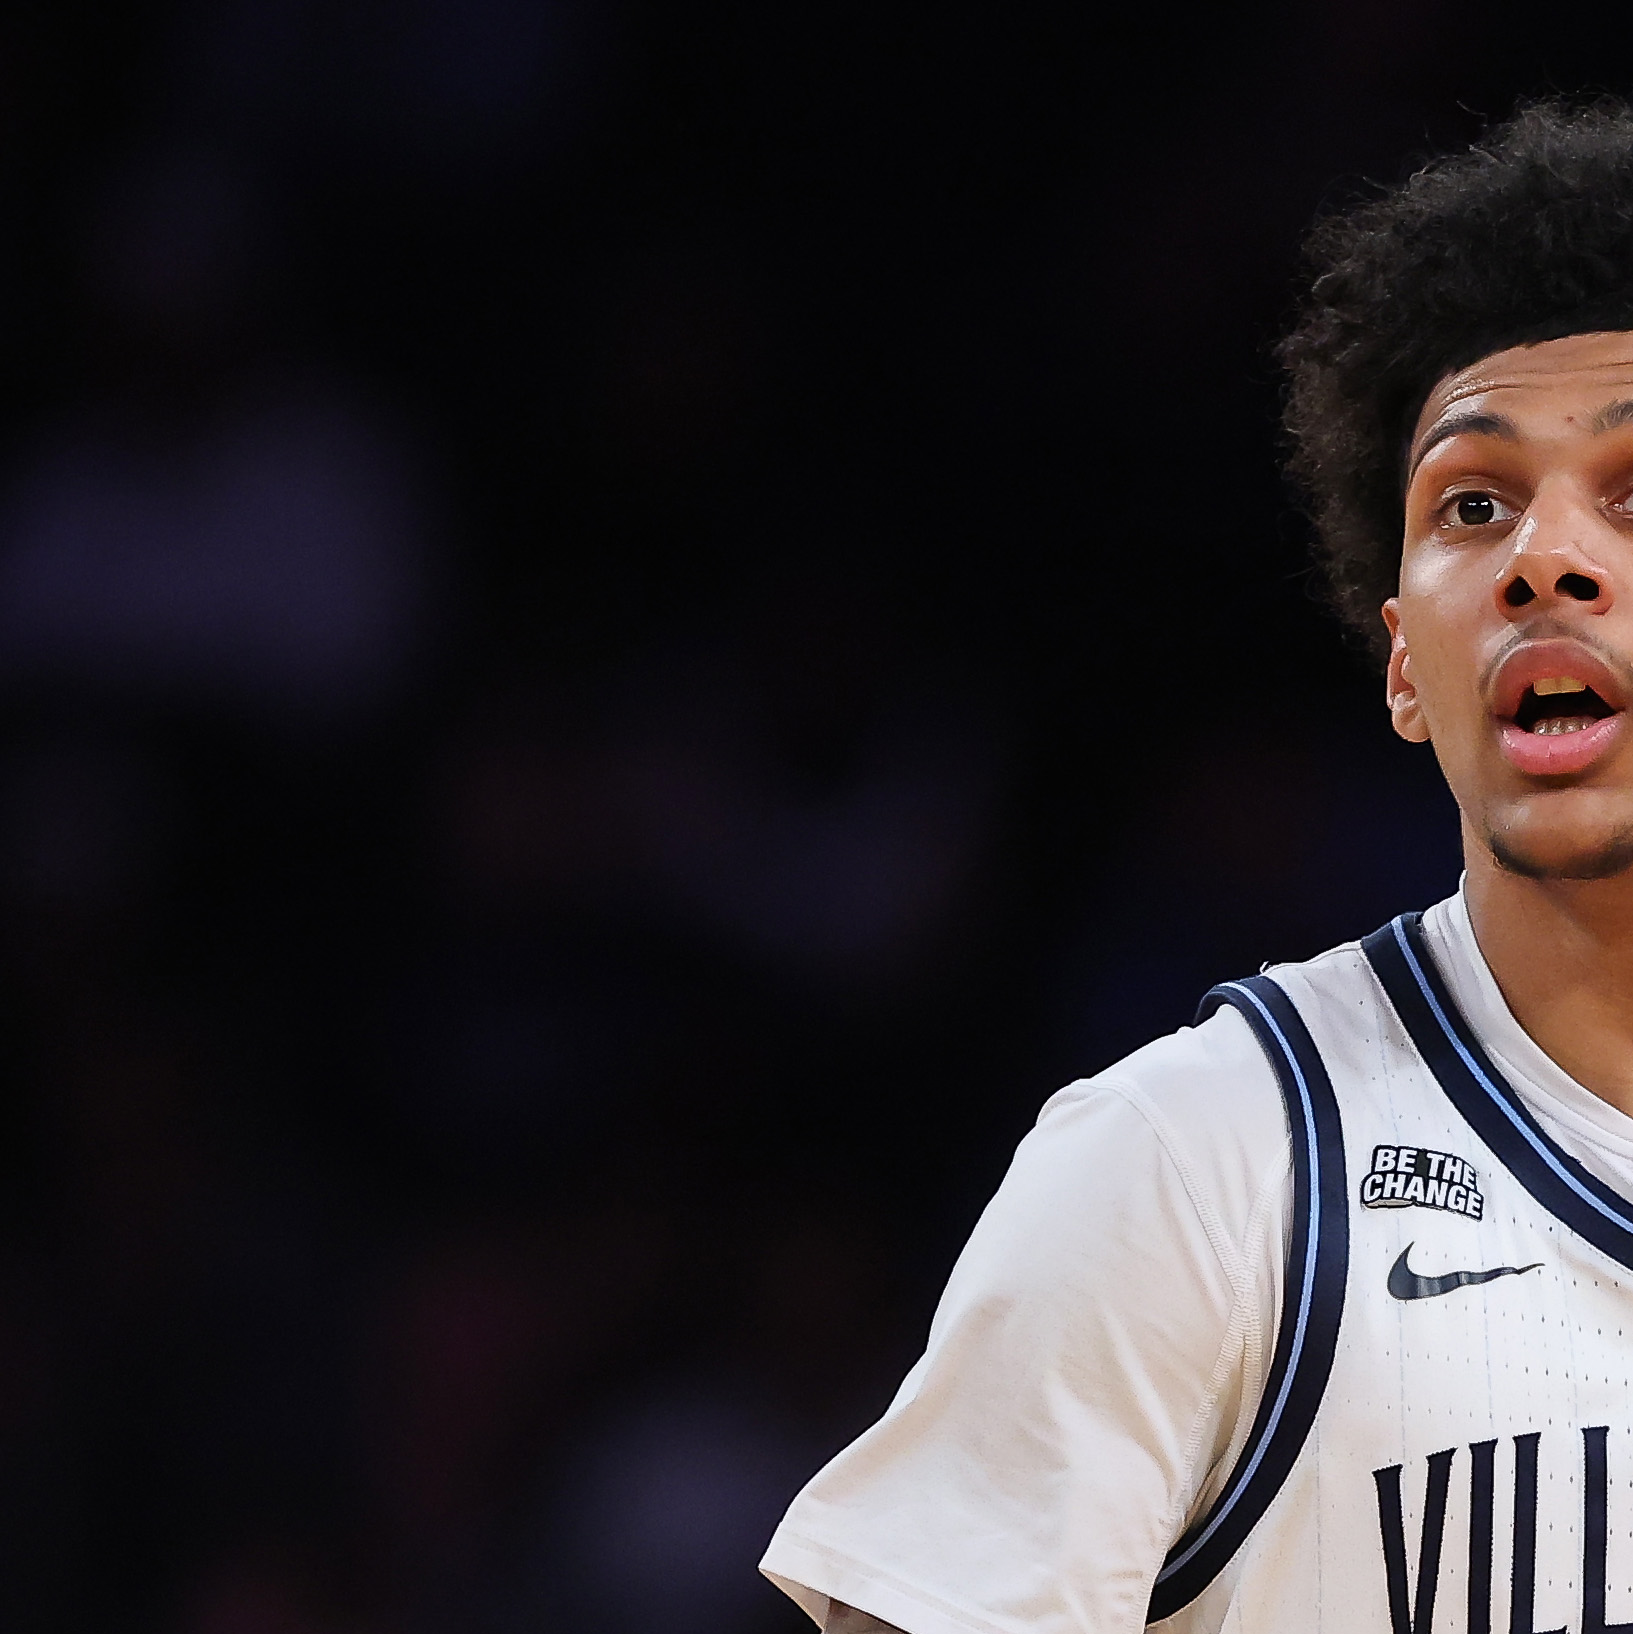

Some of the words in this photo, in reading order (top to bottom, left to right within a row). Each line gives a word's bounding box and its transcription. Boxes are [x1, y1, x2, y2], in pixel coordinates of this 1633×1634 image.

[1374, 1148, 1418, 1173] BE
[1426, 1152, 1477, 1190] THE
[1363, 1173, 1482, 1218] CHANGE
